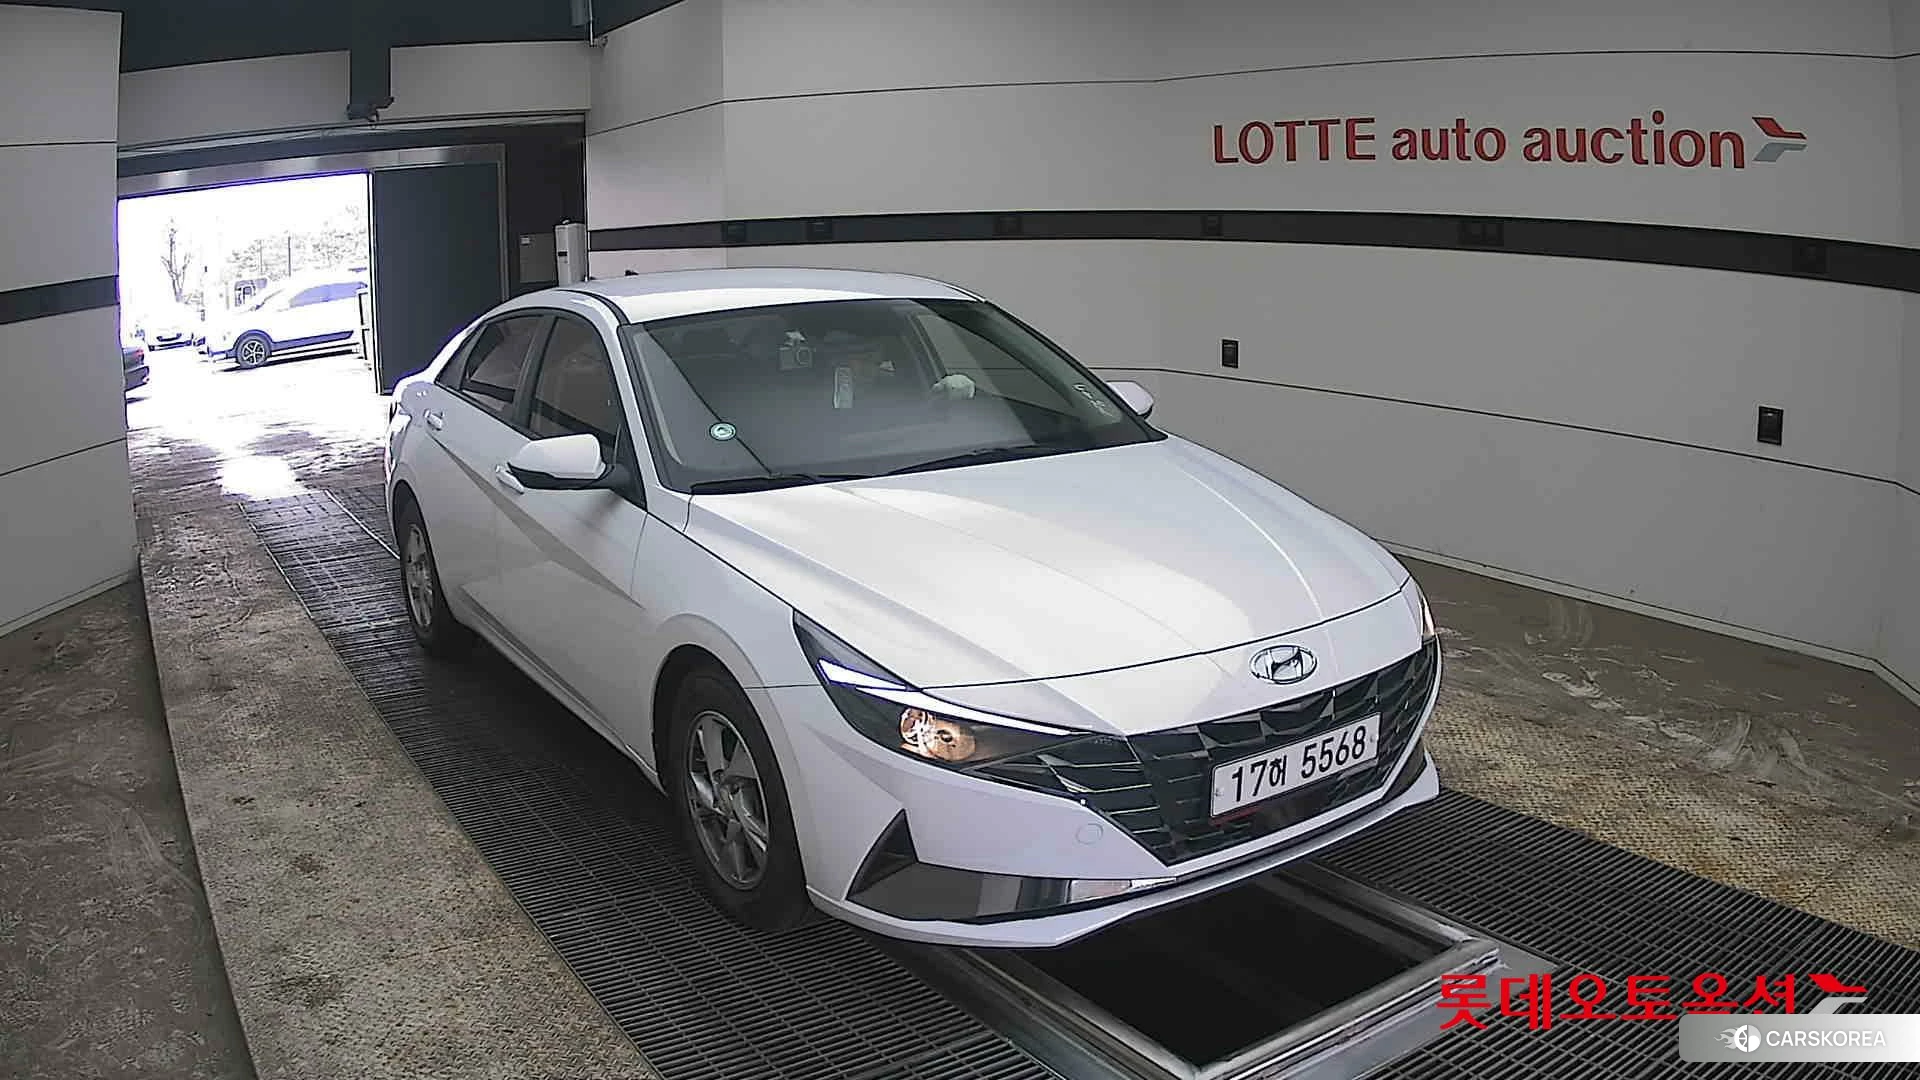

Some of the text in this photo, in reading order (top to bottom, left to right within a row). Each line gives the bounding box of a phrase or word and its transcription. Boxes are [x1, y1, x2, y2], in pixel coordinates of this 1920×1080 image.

[1213, 110, 1746, 168] LOTTE auto auction
[1231, 725, 1367, 803] 17허 5568
